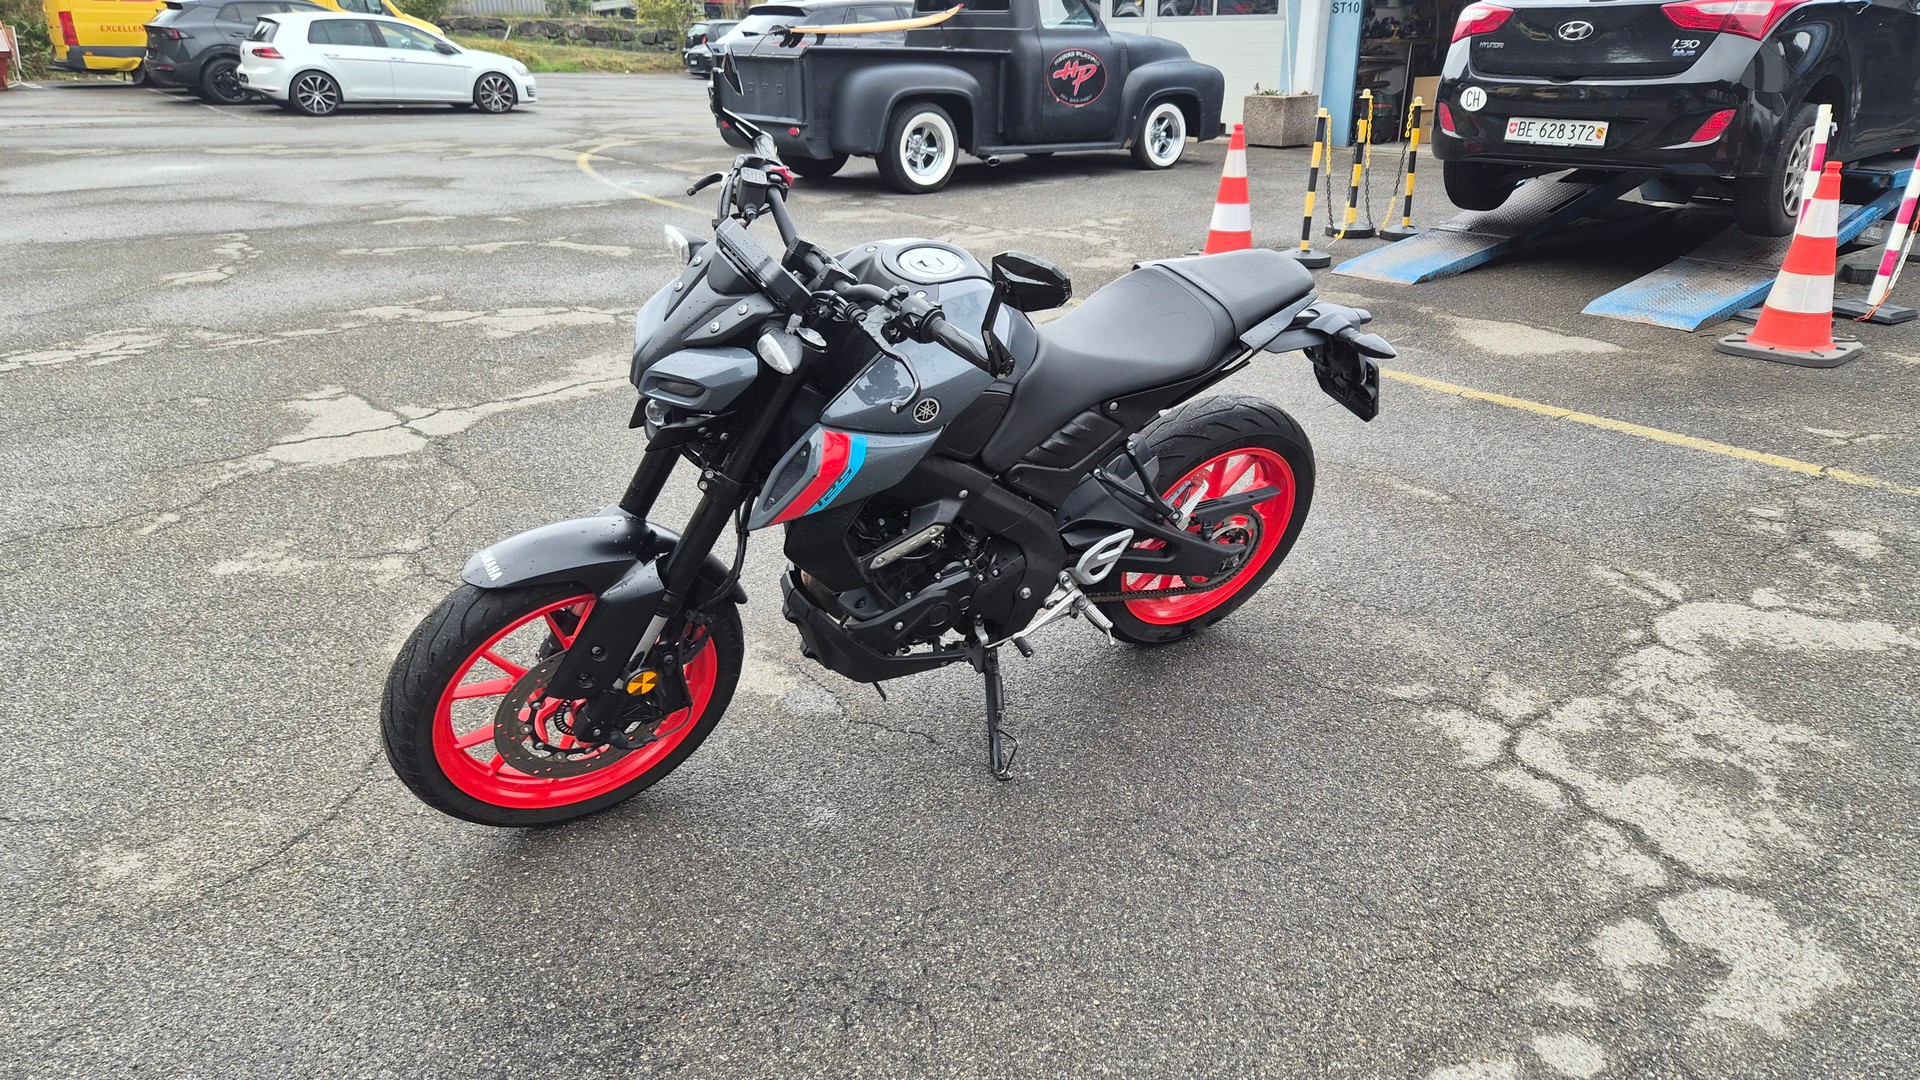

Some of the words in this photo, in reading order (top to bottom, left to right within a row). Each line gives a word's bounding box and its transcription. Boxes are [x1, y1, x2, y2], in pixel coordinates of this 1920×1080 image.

[1332, 2, 1360, 14] ST10
[100, 25, 145, 33] EXCELLEN
[1479, 41, 1505, 49] HYUNDAI
[1053, 60, 1098, 97] HP
[1465, 90, 1480, 108] CH
[818, 468, 853, 508] 125
[480, 549, 503, 582] YAMAHA
